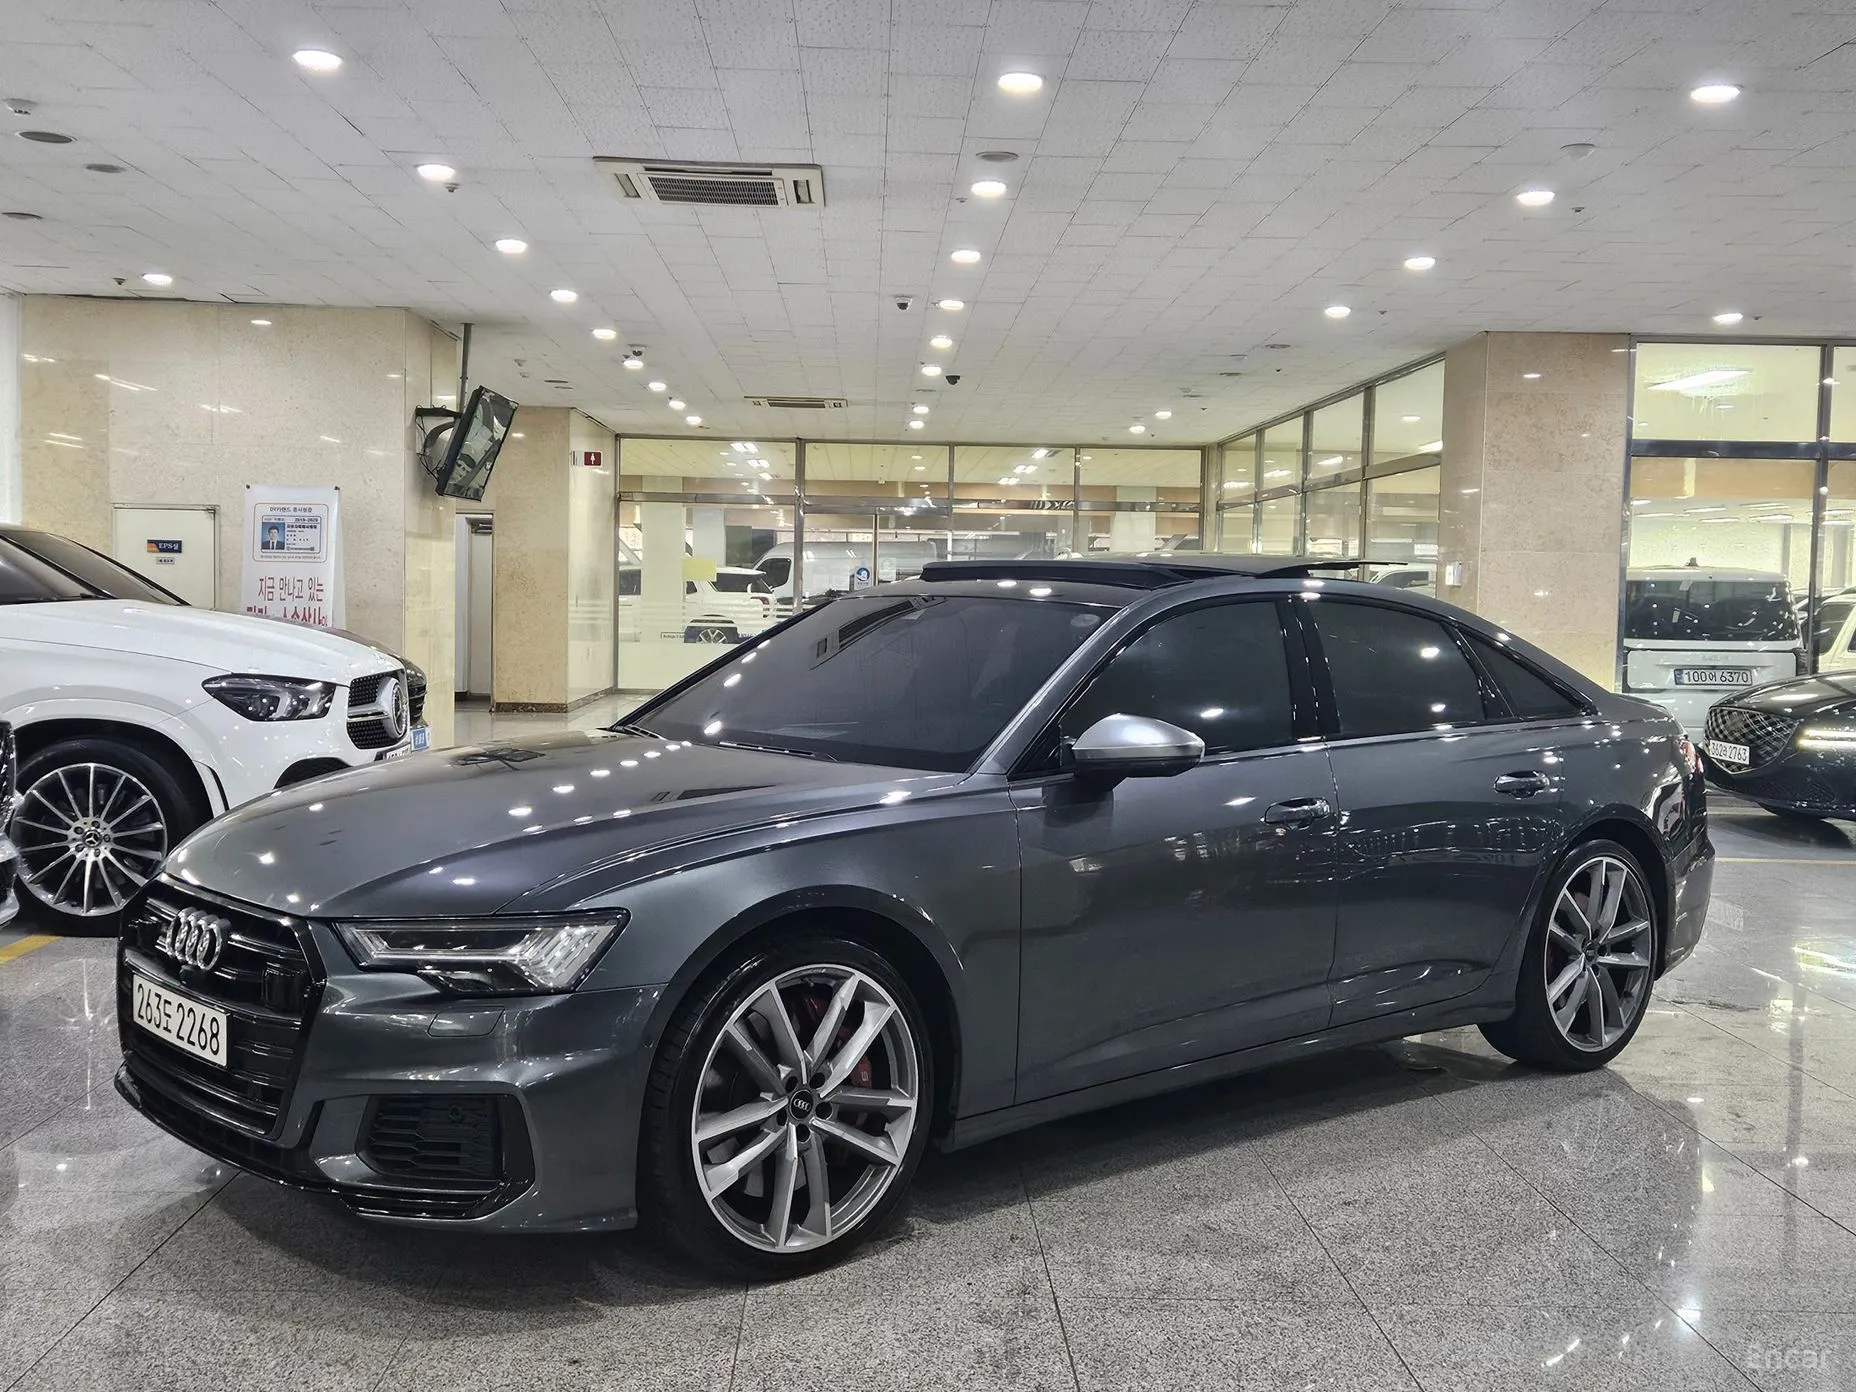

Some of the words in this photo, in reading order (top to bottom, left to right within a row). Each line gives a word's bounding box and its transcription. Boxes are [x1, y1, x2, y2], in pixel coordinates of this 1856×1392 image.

[258, 576, 275, 602] 지금
[279, 576, 304, 602] 만나고
[308, 576, 324, 602] 있는
[1720, 672, 1749, 683] 6370
[137, 983, 173, 1034] 263도
[176, 1002, 220, 1056] 2268
